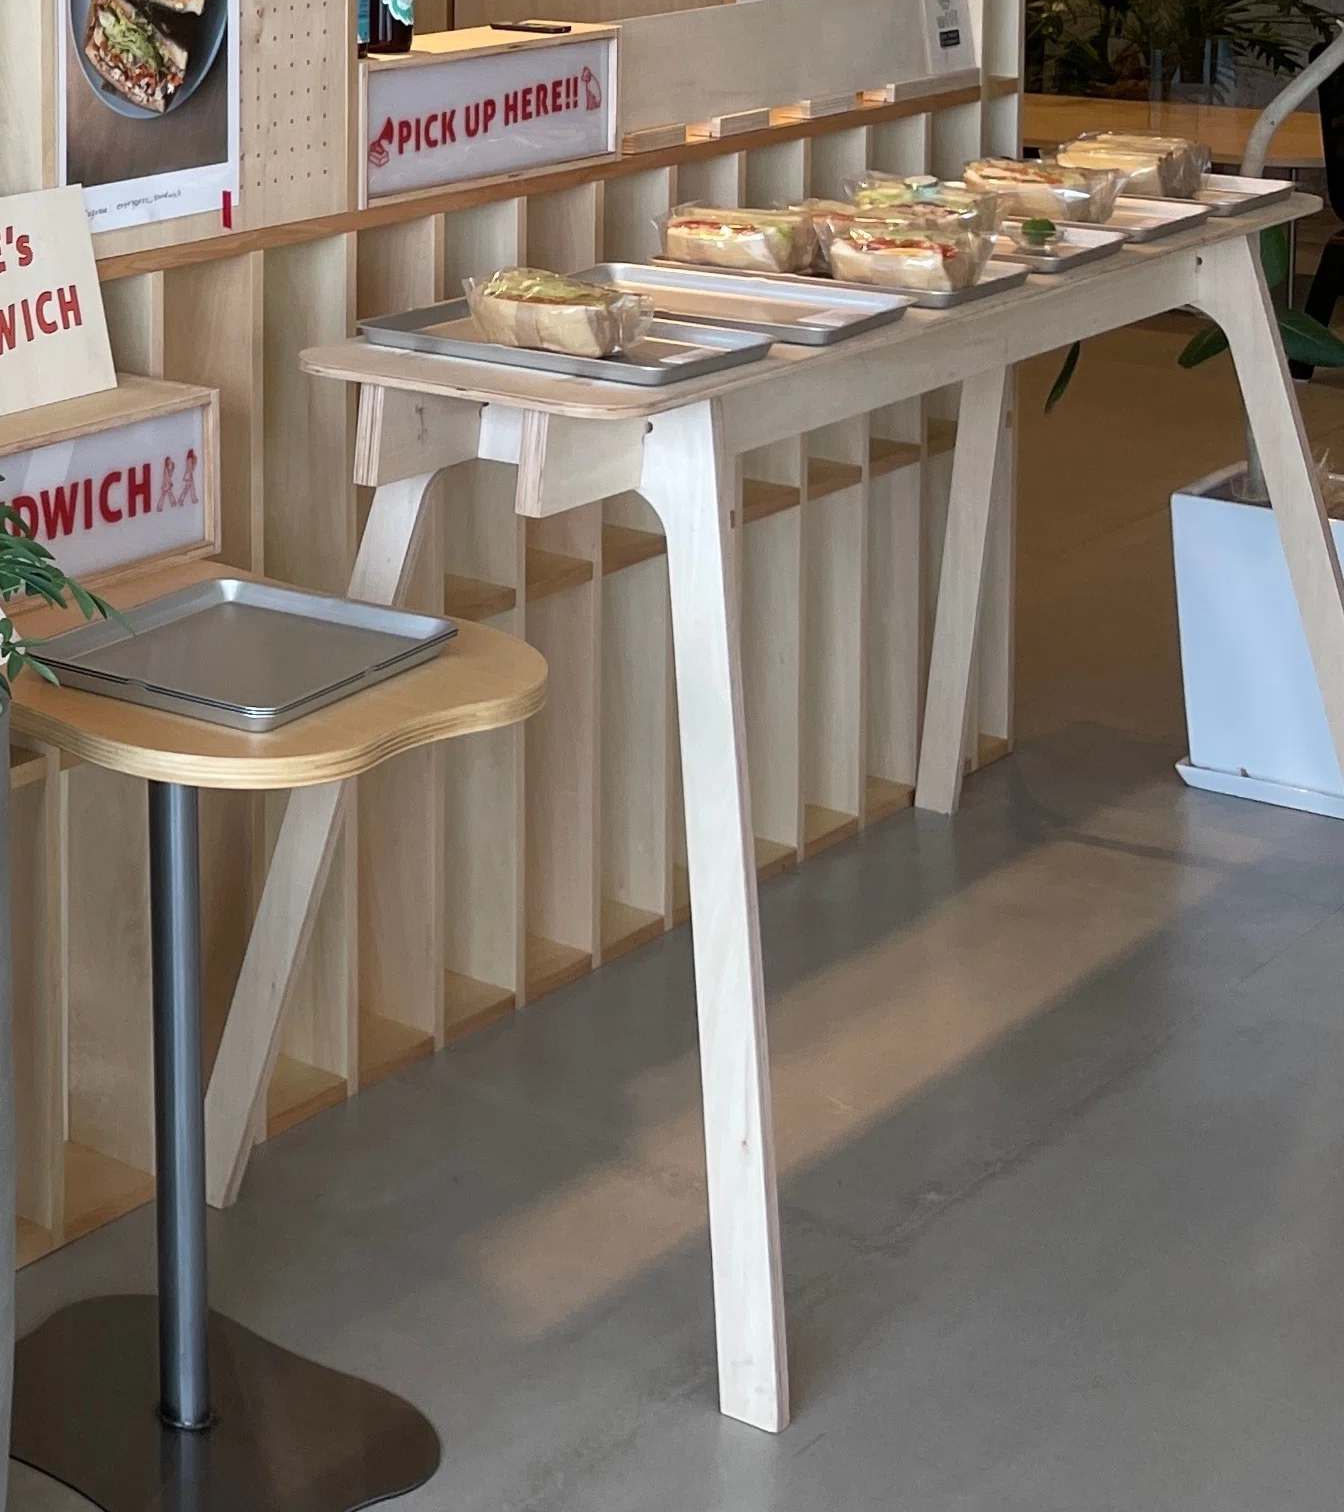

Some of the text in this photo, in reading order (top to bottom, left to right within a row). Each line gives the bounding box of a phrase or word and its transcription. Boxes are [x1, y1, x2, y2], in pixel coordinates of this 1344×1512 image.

[397, 75, 580, 155] PICK UP HERE!!
